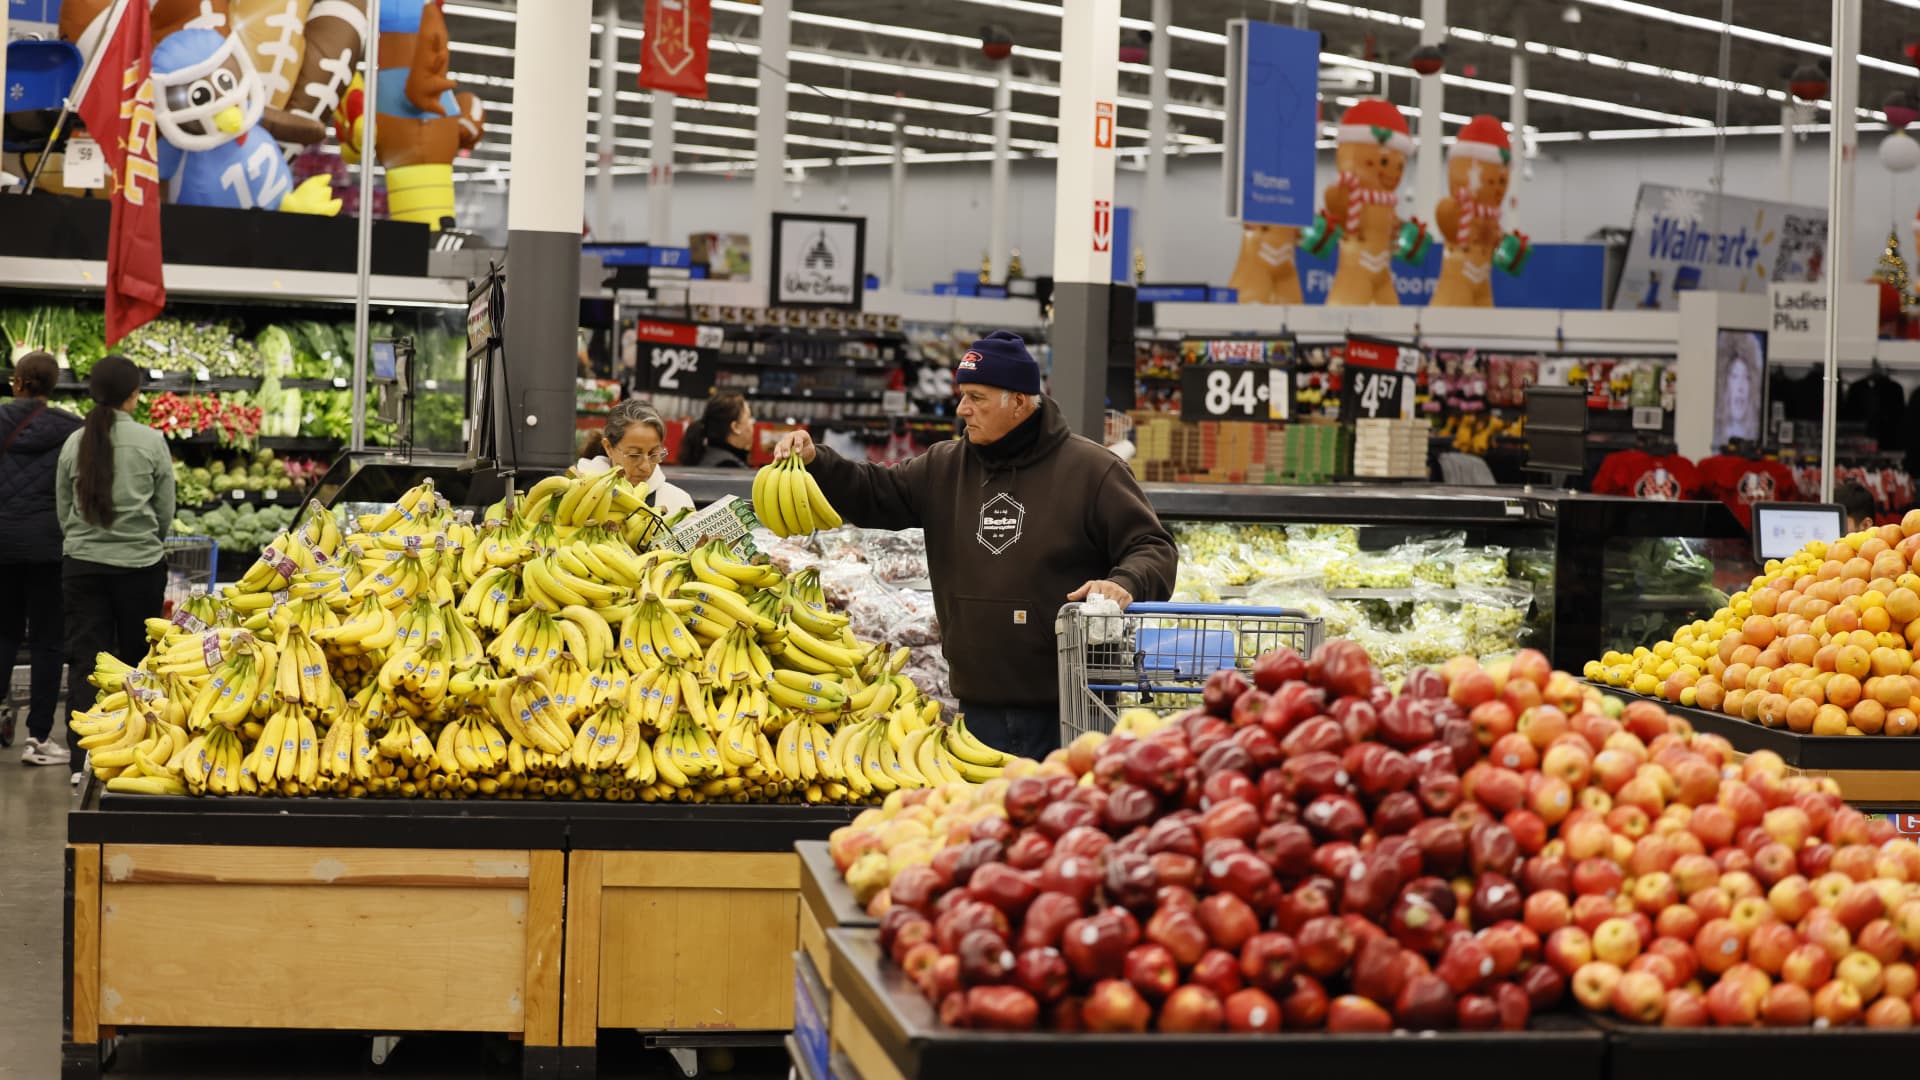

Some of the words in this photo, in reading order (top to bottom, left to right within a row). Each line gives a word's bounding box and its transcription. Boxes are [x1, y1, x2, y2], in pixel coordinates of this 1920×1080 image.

[221, 142, 288, 209] 12
[1773, 313, 1809, 332] Plus
[983, 517, 1017, 526] Beta
